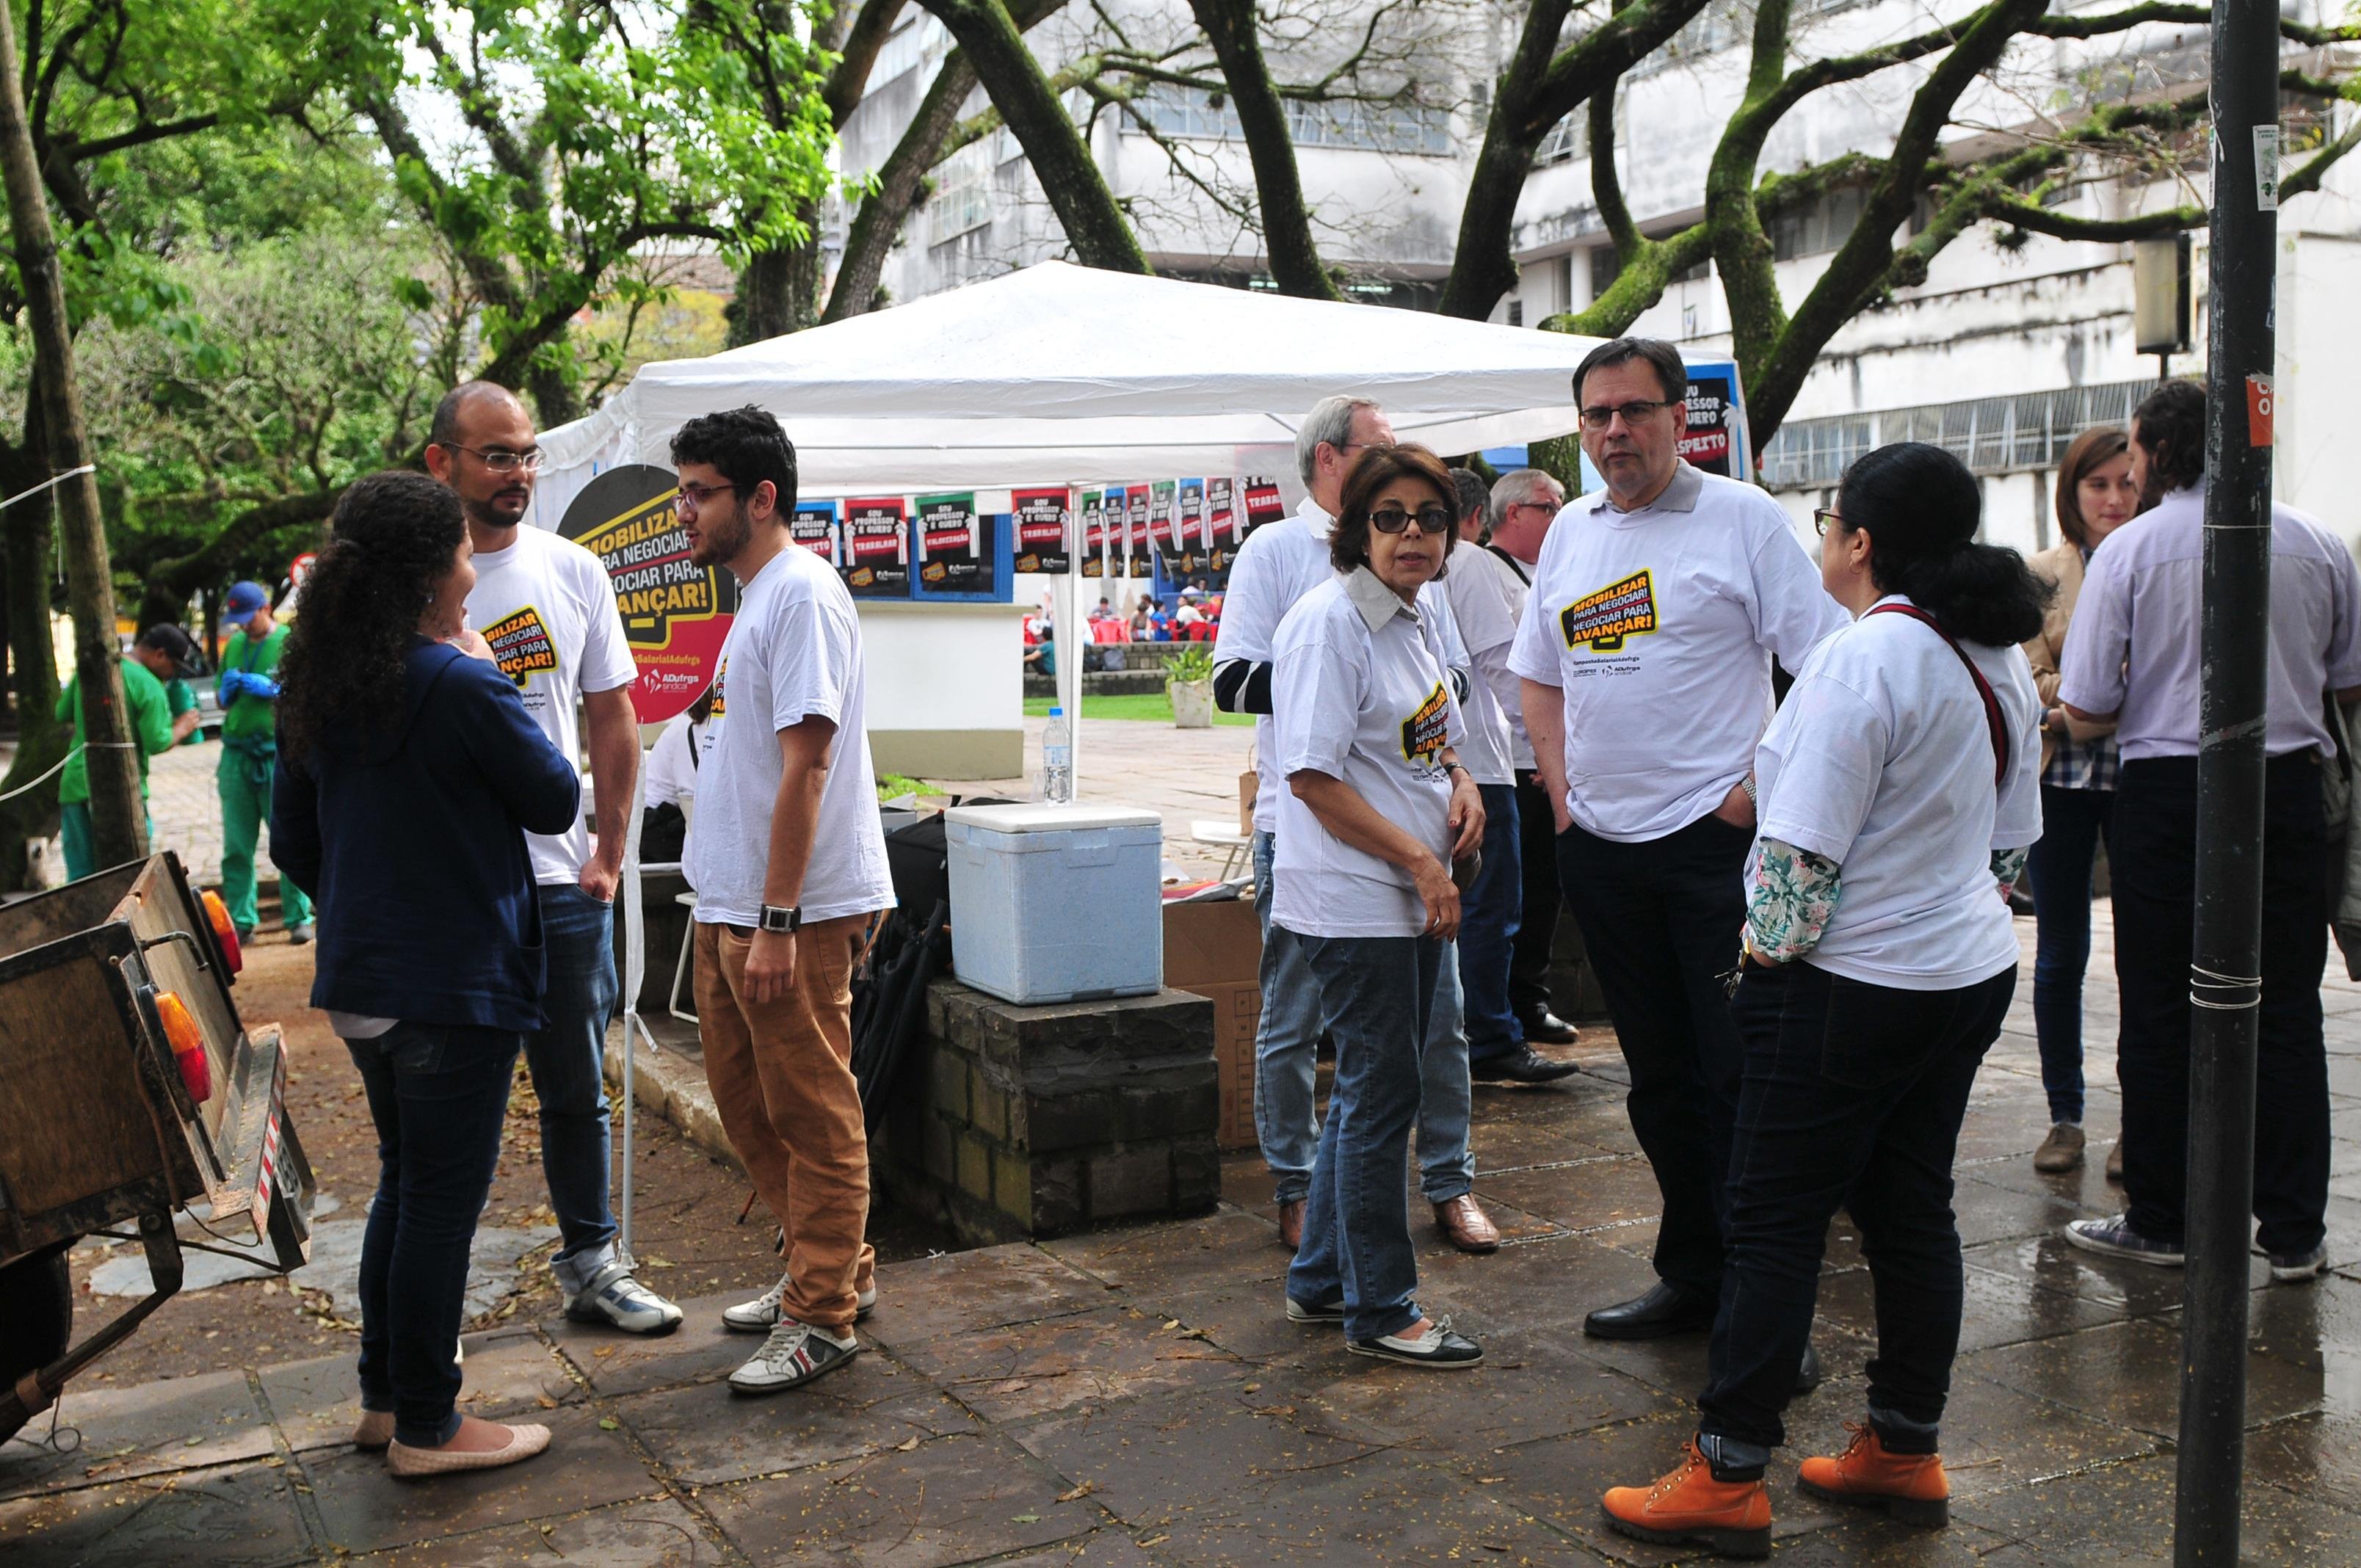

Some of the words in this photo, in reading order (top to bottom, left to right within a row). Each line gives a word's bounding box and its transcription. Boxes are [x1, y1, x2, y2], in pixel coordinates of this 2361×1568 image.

[1686, 385, 1699, 397] OU
[1686, 397, 1719, 410] ESSOR
[1686, 411, 1717, 425] UERO
[1677, 433, 1725, 454] SPEITO
[1248, 495, 1280, 508] TRABA
[584, 508, 680, 556] MOBILIZA
[601, 551, 620, 570] RA
[611, 567, 660, 593] OCIAR
[618, 582, 707, 617] ANÇAR!
[1573, 576, 1647, 613] MOBILIZAR
[1573, 608, 1597, 621] PARA
[1599, 588, 1647, 612] NEGOCIAR!
[485, 612, 537, 642] BILIZAR
[1573, 611, 1621, 632] NEGOCIAR
[1623, 603, 1651, 617] PARA
[1573, 615, 1652, 642] AVANÇAR!
[493, 625, 543, 650] NEGOCIAR!
[496, 647, 518, 662] CIAR
[521, 640, 549, 655] PARA
[500, 653, 553, 673] NÇAR!
